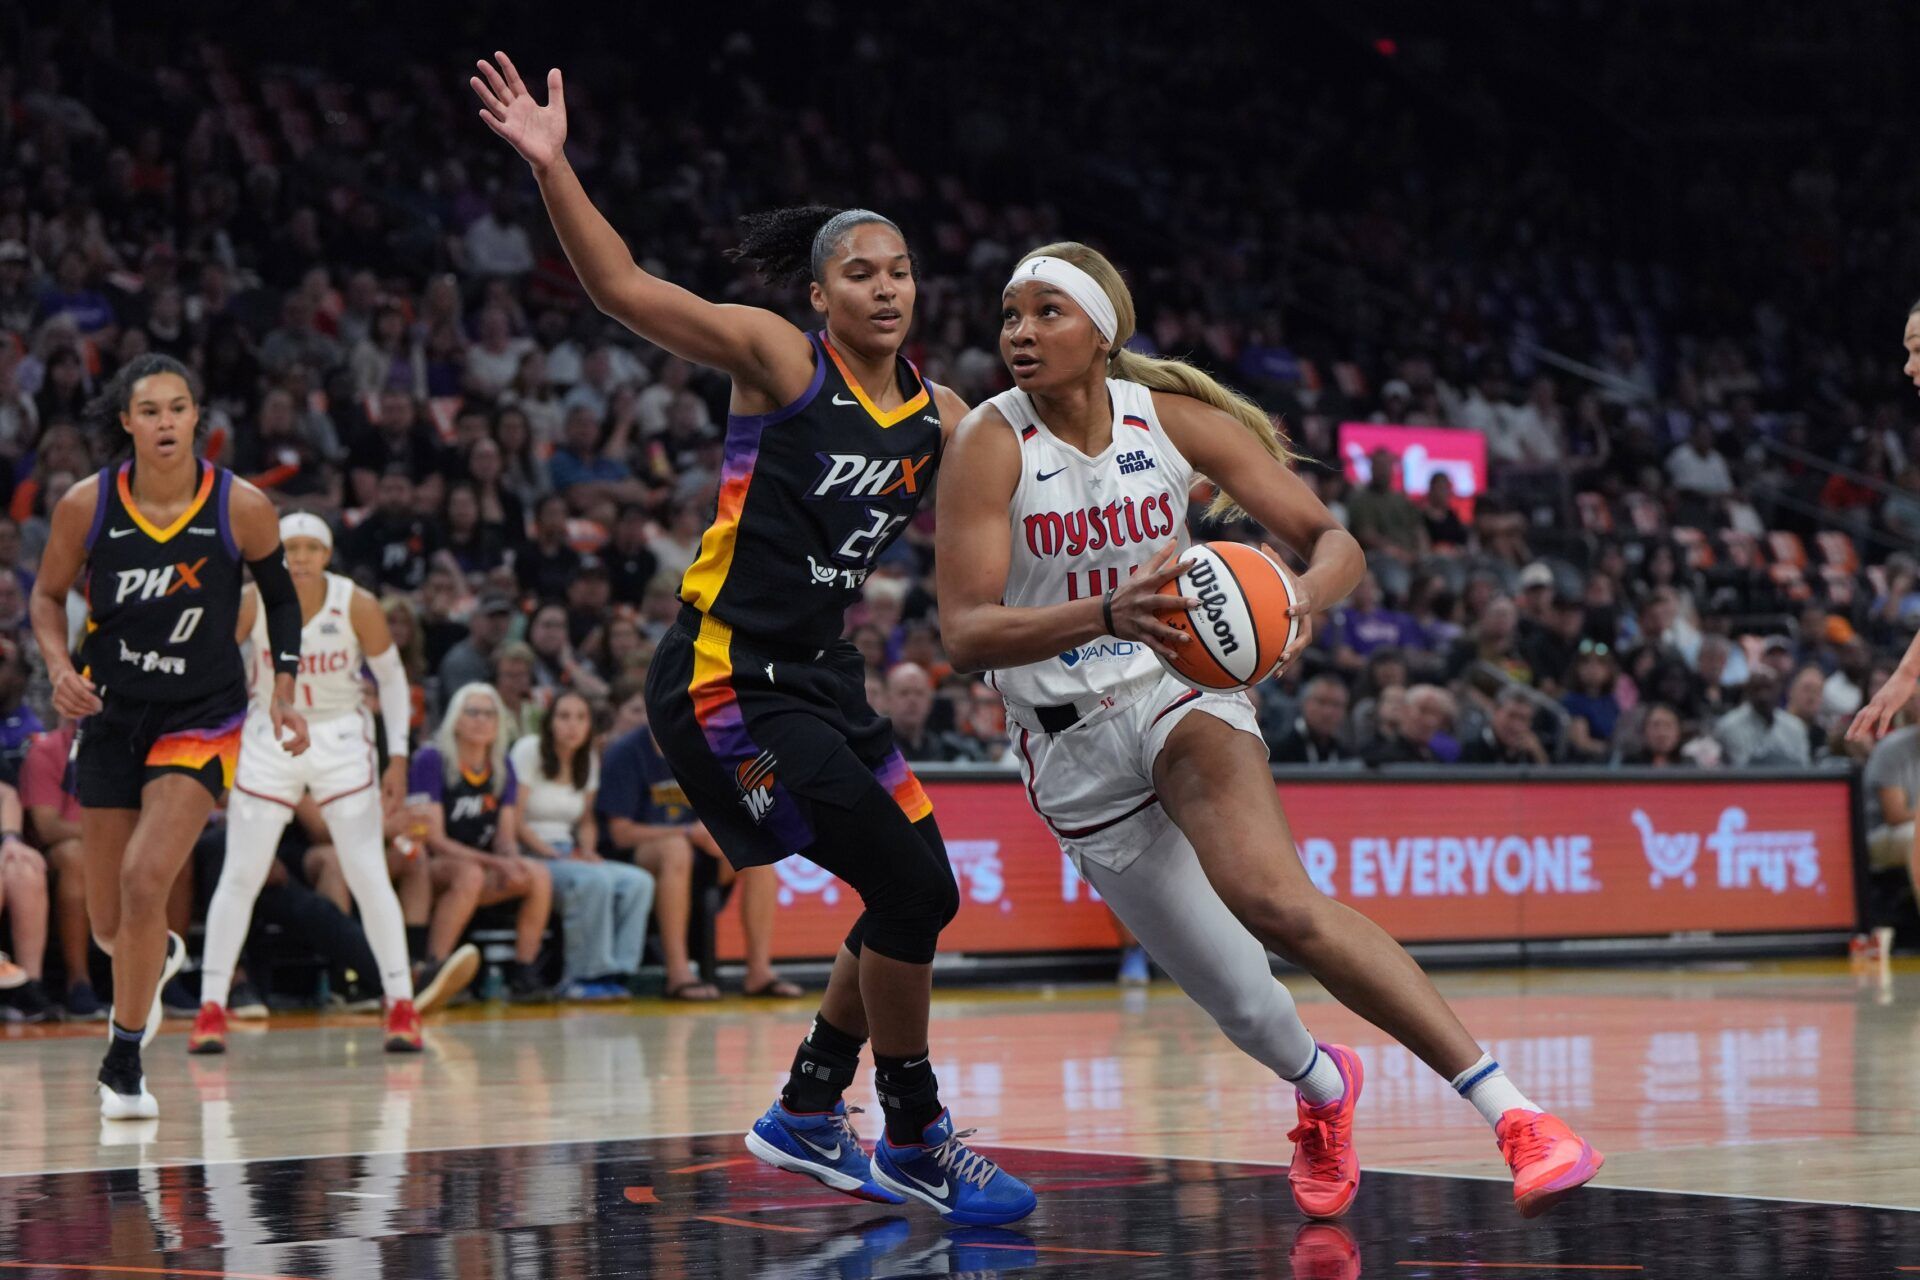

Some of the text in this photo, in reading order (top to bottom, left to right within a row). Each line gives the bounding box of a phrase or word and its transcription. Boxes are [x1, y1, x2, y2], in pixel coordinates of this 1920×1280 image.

[812, 454, 932, 497] PHX
[1116, 450, 1146, 464] CAR
[1119, 458, 1156, 475] max
[1022, 492, 1174, 560] mystics
[116, 557, 208, 604] PHX
[168, 607, 204, 644] 0
[1187, 558, 1240, 657] Wilson
